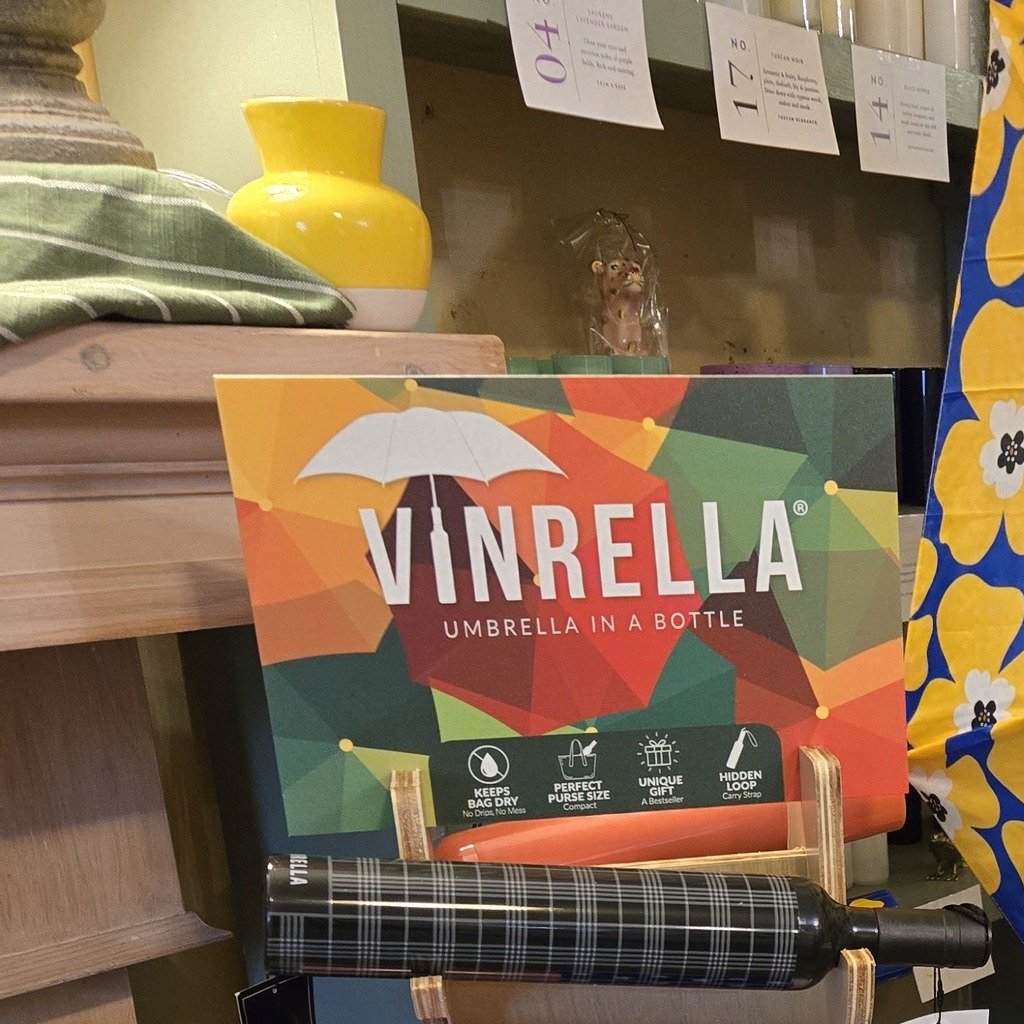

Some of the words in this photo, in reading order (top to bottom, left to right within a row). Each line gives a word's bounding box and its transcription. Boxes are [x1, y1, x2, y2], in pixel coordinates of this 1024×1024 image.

[443, 616, 580, 639] UMBRELLA
[591, 614, 616, 633] IN
[628, 613, 643, 632] A
[655, 609, 745, 631] BOTTLE
[638, 774, 684, 788] UNIQUE
[719, 769, 763, 782] HIDDEN
[474, 786, 511, 799] KEEPS
[553, 780, 603, 793] PERFECT
[649, 785, 675, 797] GIFT
[726, 780, 758, 792] LOOP
[547, 792, 586, 804] PURSE
[586, 789, 611, 801] SIZE
[641, 798, 648, 806] A
[649, 795, 685, 805] Bestseller
[722, 792, 743, 801] Carry
[742, 790, 763, 800] Strap
[467, 797, 492, 810] BAG
[494, 795, 519, 808] DRY
[562, 801, 598, 812] Compact
[462, 809, 474, 818] No
[495, 806, 507, 816] No
[507, 806, 527, 815] Mess
